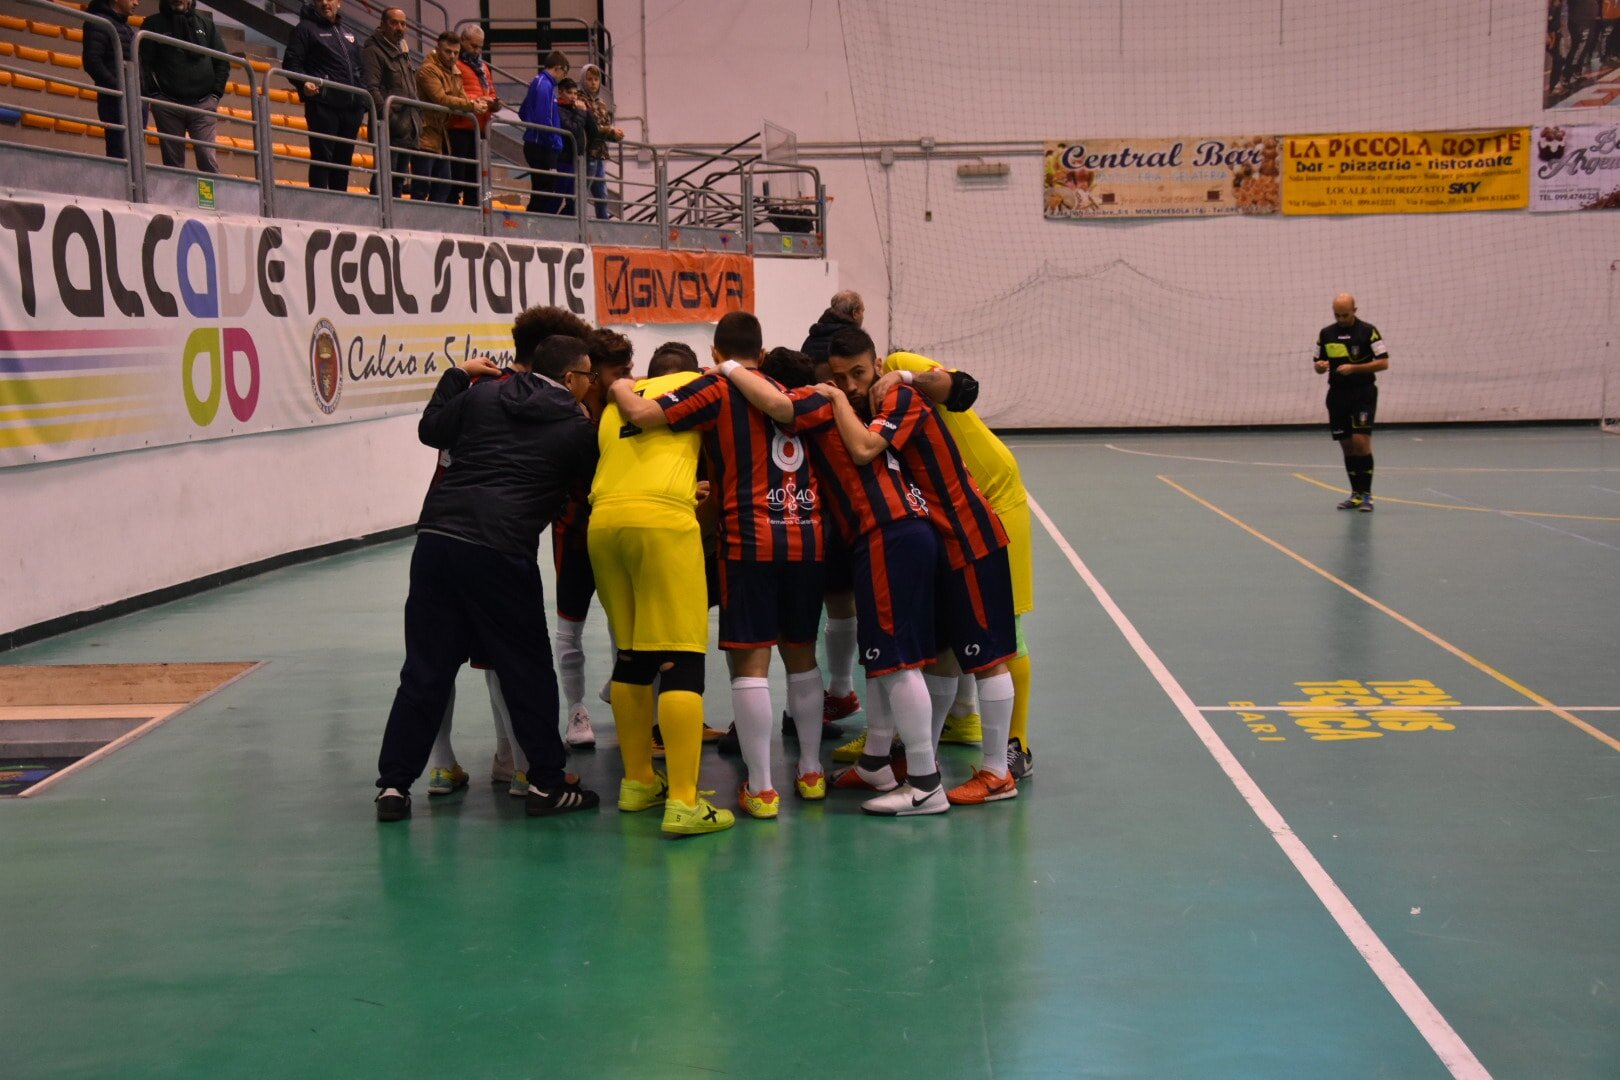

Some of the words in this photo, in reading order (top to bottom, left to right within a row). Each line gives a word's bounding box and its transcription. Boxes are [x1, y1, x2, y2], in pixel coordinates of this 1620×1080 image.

[1061, 142, 1183, 170] Central
[1193, 140, 1264, 167] Bar
[1290, 140, 1321, 158] LA
[1329, 136, 1432, 157] PICCOLA
[1441, 133, 1521, 156] BOTTE
[1296, 161, 1323, 173] bar
[1340, 158, 1411, 173] pizzeria
[1428, 155, 1513, 170] ristorante
[1326, 187, 1368, 195] LOCALE
[1447, 181, 1481, 195] SKY
[631, 268, 745, 309] GIVOVA
[348, 335, 417, 382] Calcio
[424, 352, 437, 372] a
